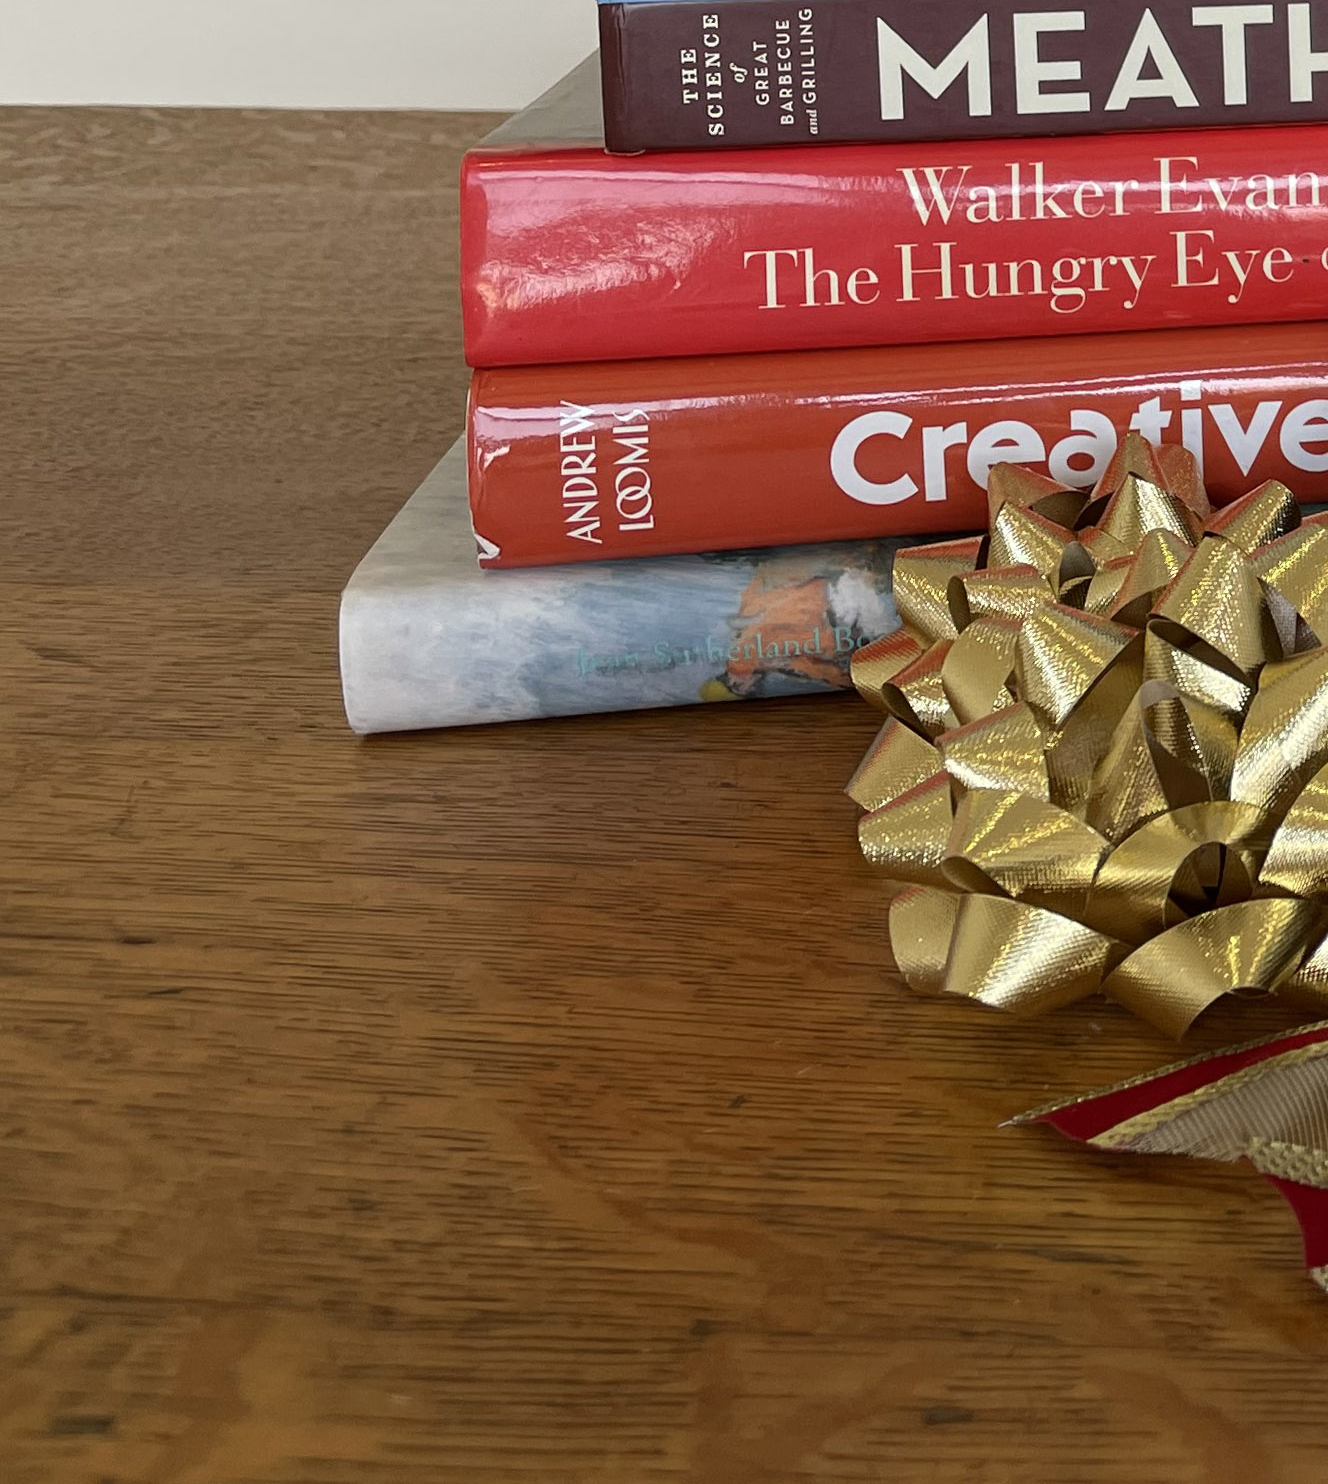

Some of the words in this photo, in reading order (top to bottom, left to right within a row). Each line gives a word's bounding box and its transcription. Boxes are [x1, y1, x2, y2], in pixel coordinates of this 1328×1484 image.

[681, 48, 699, 104] THE
[702, 14, 725, 136] SCIENCE
[729, 62, 748, 83] of
[753, 41, 770, 106] GREAT
[775, 19, 795, 125] BARBECUE
[798, 8, 817, 104] GRILLING
[805, 109, 819, 135] and
[897, 158, 1138, 227] Walker
[743, 245, 879, 311] The
[894, 240, 1157, 314] Hungry
[1170, 229, 1294, 305] Eye
[559, 400, 603, 544] ANDREW
[612, 409, 655, 531] LOOMIS
